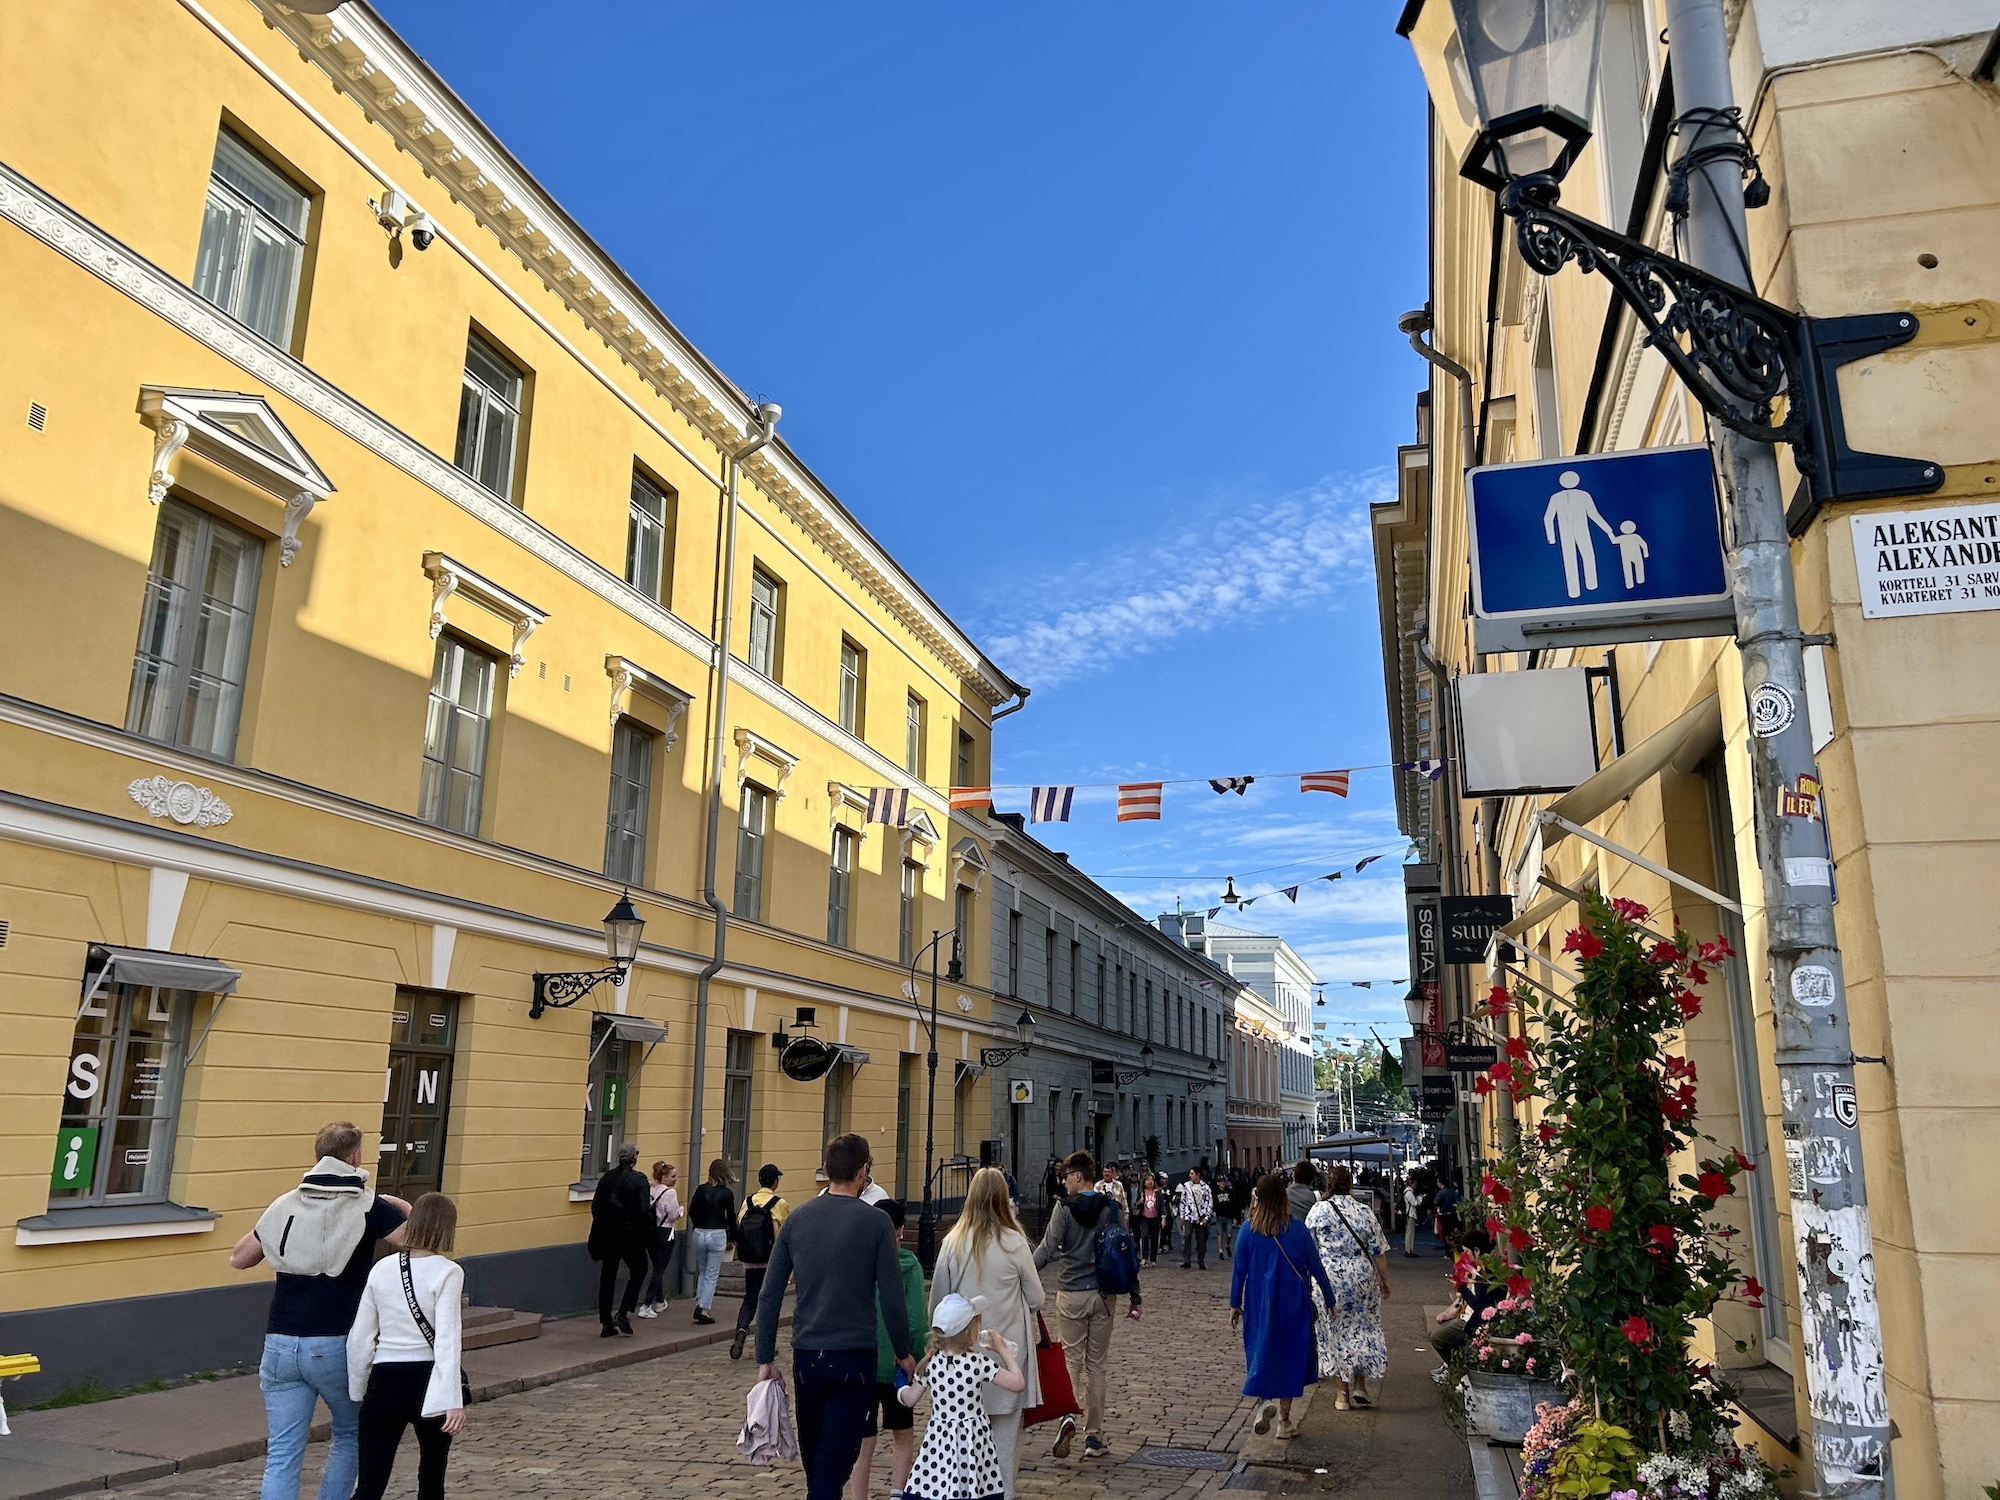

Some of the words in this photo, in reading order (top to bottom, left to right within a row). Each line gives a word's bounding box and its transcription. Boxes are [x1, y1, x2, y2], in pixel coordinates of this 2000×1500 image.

[1873, 515, 2000, 547] ALEKSANT
[1879, 576, 1937, 592] KORTTELI
[1944, 575, 1960, 587] 31
[1967, 571, 1999, 585] SARV
[1881, 588, 1952, 605] KVARTERET
[1961, 587, 1977, 600] 31
[1418, 908, 1436, 974] SOFIA
[67, 1053, 101, 1099] S
[416, 1069, 439, 1104] N
[1424, 1086, 1452, 1094] SOFIA
[402, 1270, 421, 1319] marimekko
